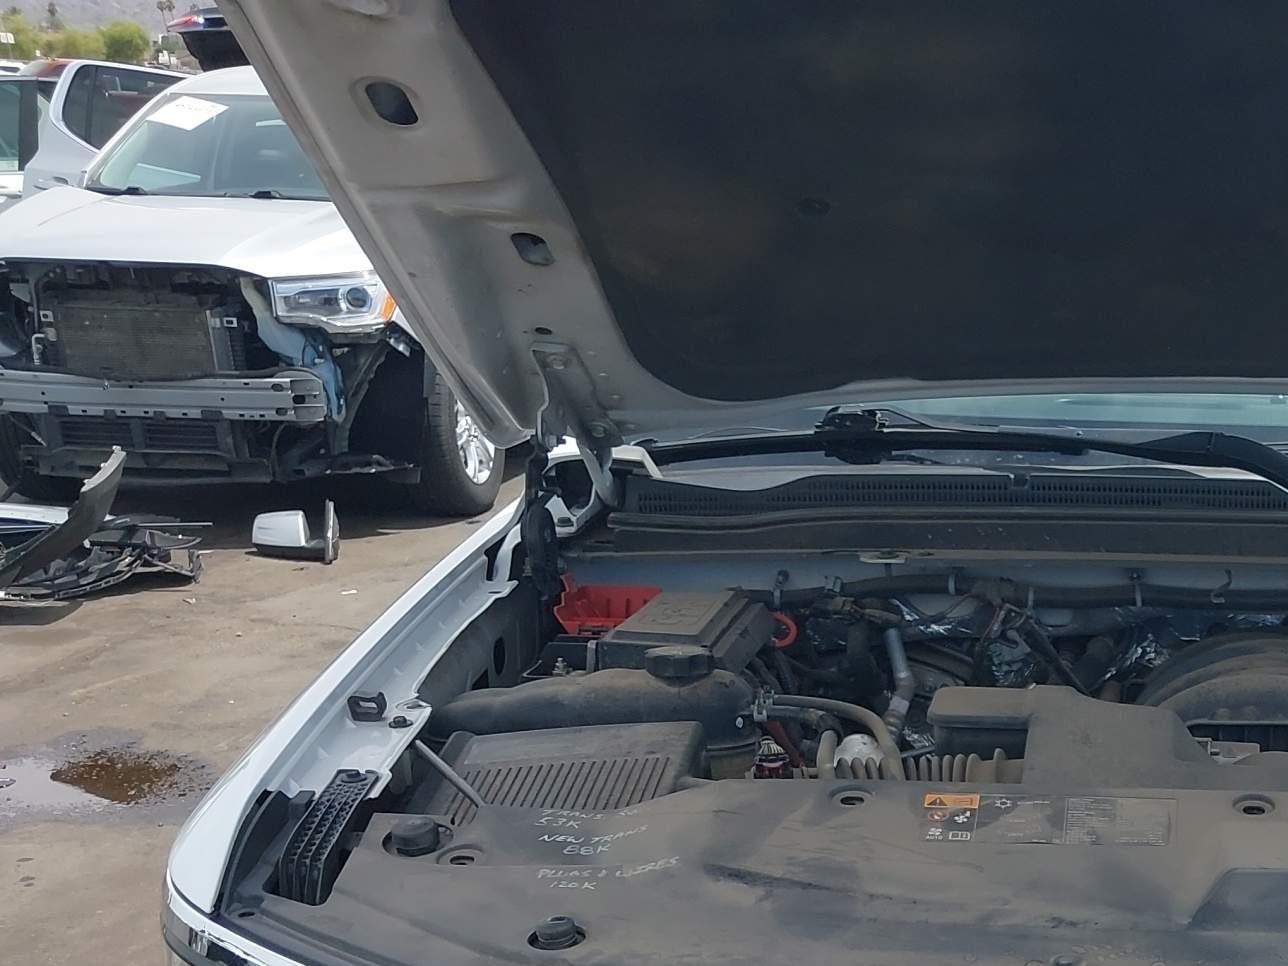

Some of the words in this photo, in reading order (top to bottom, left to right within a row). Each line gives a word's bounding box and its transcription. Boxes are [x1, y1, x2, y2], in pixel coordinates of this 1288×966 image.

[535, 816, 581, 829] 53K
[538, 833, 584, 844] NEW
[562, 844, 611, 856] 88K
